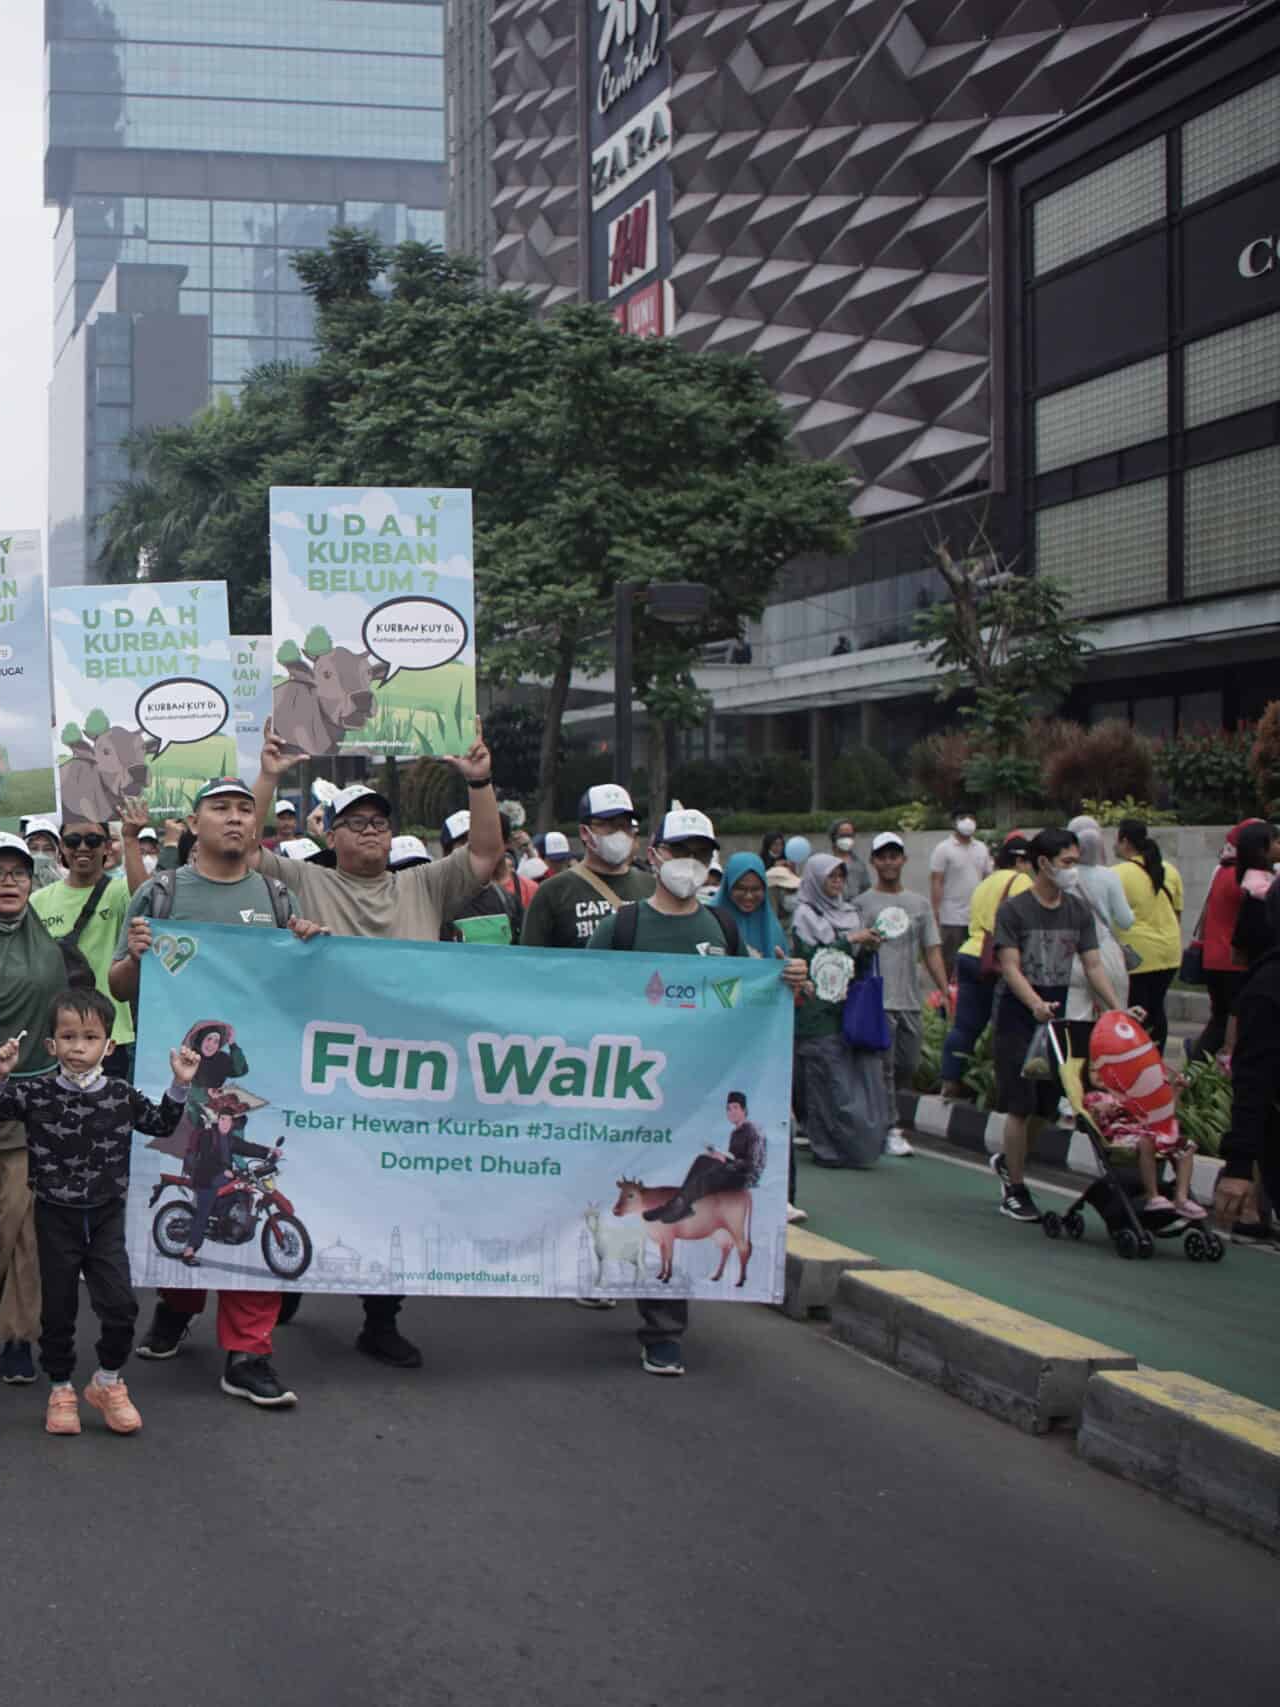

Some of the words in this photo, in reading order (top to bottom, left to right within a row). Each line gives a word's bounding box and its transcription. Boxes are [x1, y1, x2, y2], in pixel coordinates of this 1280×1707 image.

[597, 12, 659, 114] Central
[592, 110, 670, 196] ZARA
[306, 513, 438, 537] UDAH
[306, 541, 438, 565] KURBAN
[307, 569, 413, 592] BELUM
[82, 605, 198, 629] UDAH
[376, 623, 419, 633] KURBAN
[83, 630, 199, 654] KURBAN
[85, 656, 177, 679] BELUM
[665, 984, 696, 999] C20
[311, 1030, 449, 1091] Fun
[477, 1042, 657, 1101] Walk
[282, 1109, 344, 1131] Tebar
[352, 1113, 430, 1135] Hewan
[438, 1117, 519, 1139] Kurban
[526, 1122, 673, 1144] #JadiManfaat
[380, 1150, 473, 1174] Dompet
[480, 1155, 562, 1177] Dhuafa
[395, 1268, 540, 1285] www.dompetdhuafa.org
